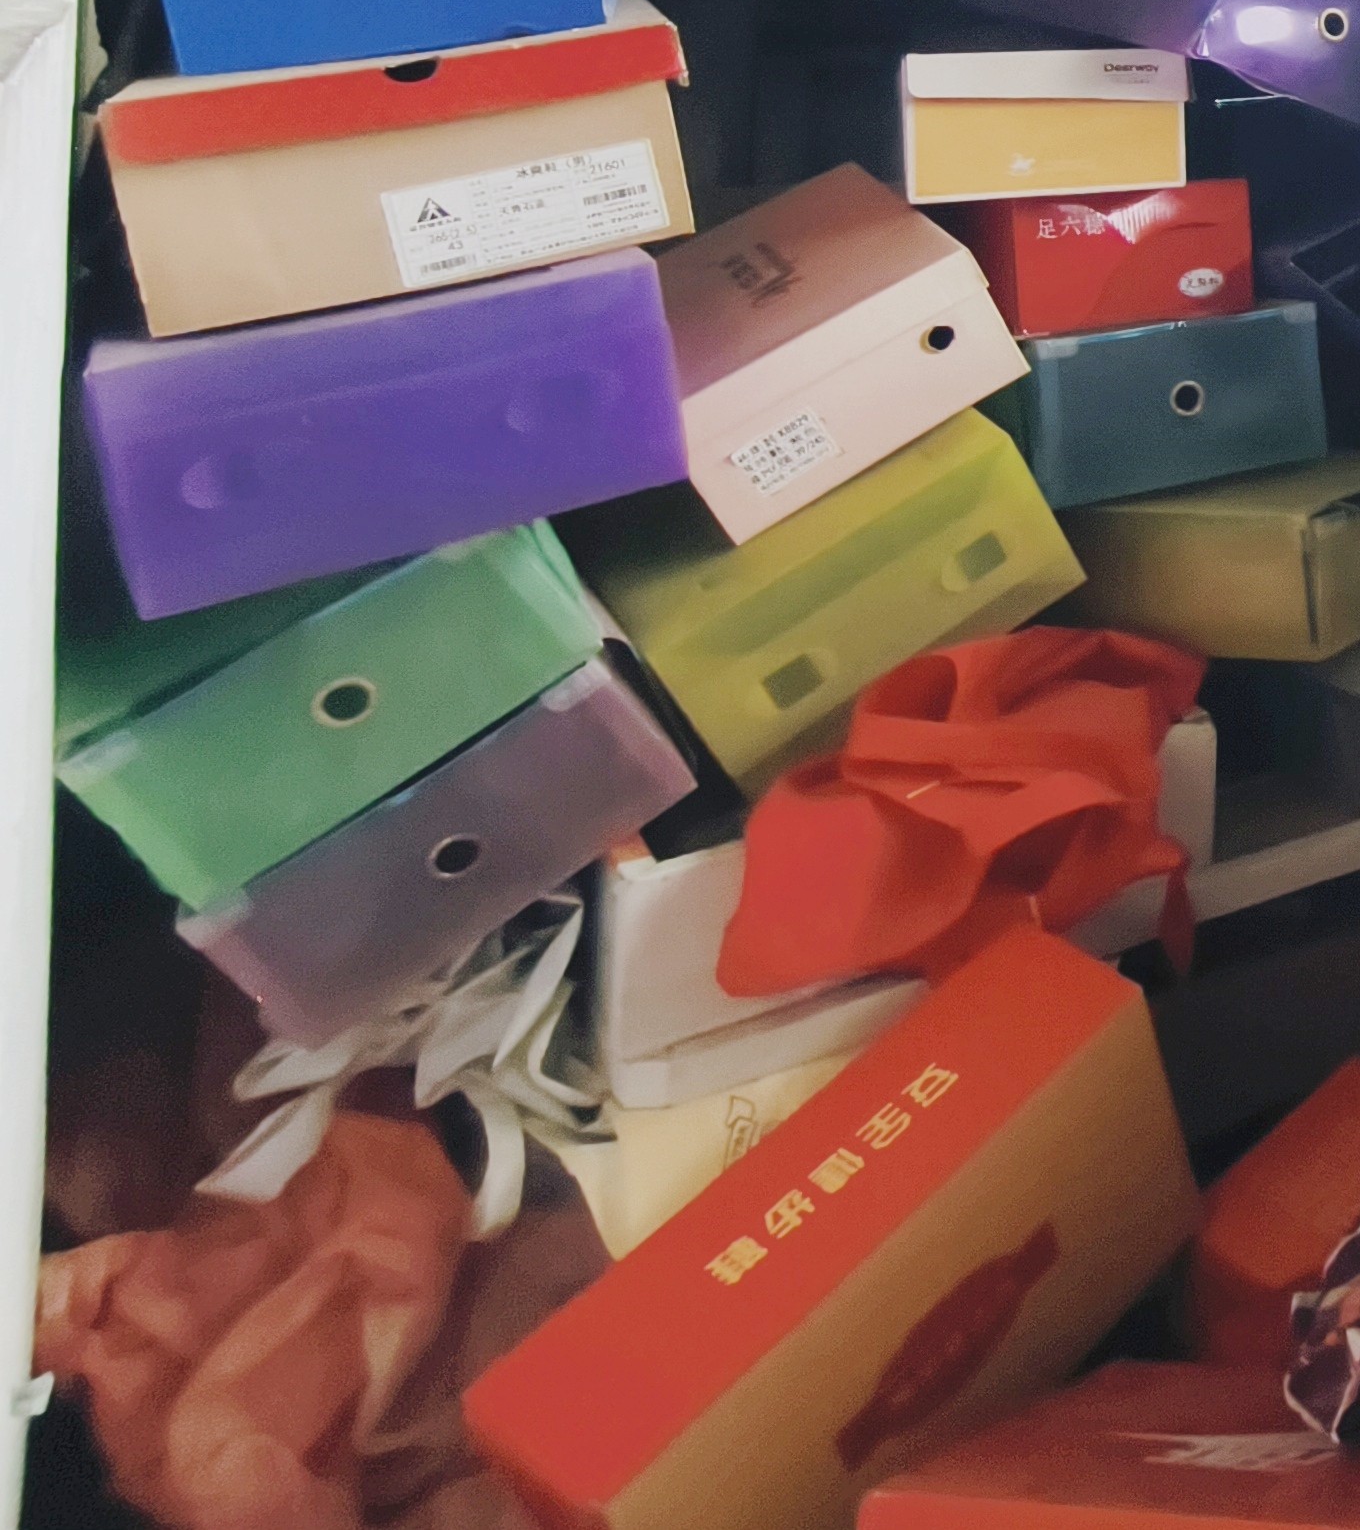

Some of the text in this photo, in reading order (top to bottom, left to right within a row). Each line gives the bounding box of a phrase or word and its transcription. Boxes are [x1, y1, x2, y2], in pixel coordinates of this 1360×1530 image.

[703, 1062, 960, 1286] 安全健步鞋
